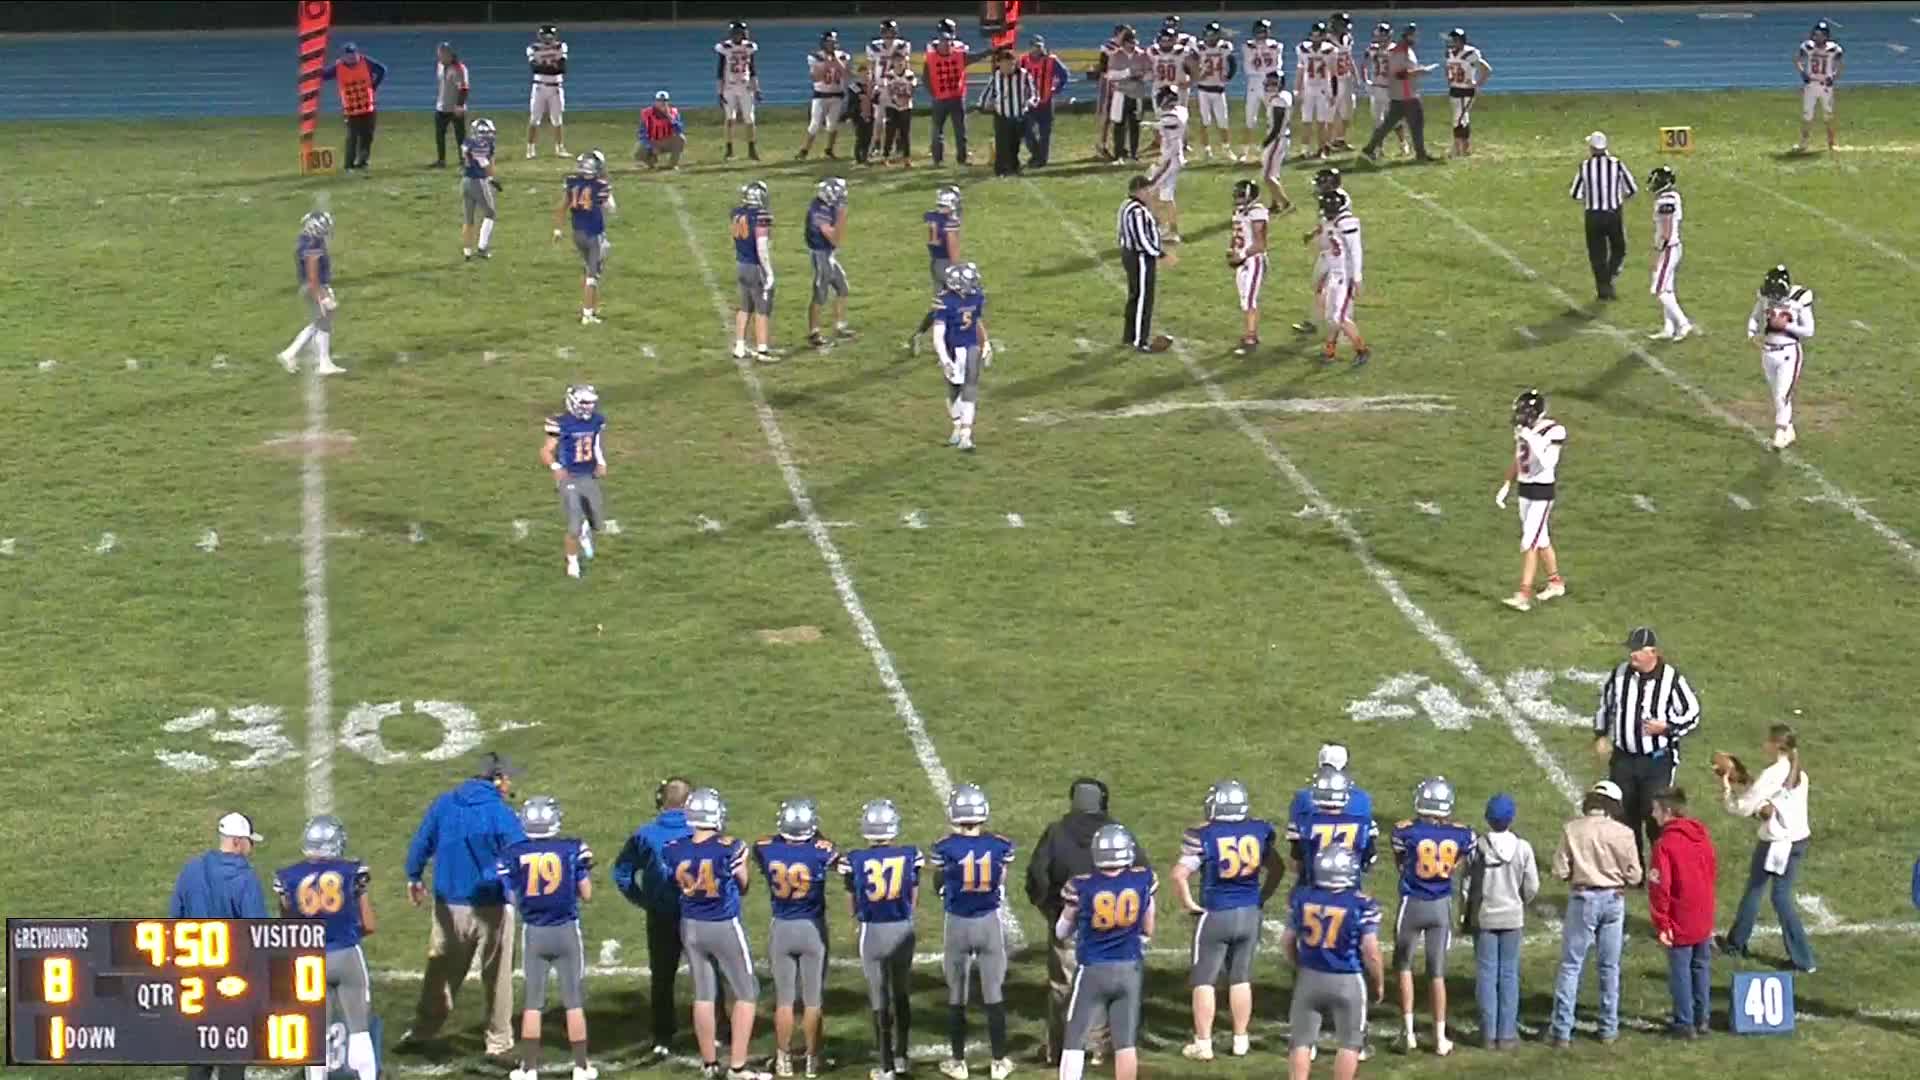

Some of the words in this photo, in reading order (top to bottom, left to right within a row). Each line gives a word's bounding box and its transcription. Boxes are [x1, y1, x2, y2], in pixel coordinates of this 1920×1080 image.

[1664, 129, 1688, 148] 30
[568, 185, 592, 209] 14
[959, 312, 972, 331] 5
[573, 437, 593, 463] 13
[154, 699, 490, 771] 30
[519, 851, 563, 897] 79
[957, 849, 993, 893] 11
[1217, 834, 1261, 880] 59
[1415, 838, 1460, 879] 88
[297, 870, 345, 916] 68
[675, 859, 720, 899] 64
[767, 862, 811, 900] 39
[863, 855, 906, 902] 37
[1092, 890, 1140, 930] 80
[1303, 902, 1346, 949] 57
[1744, 976, 1784, 1027] 40
